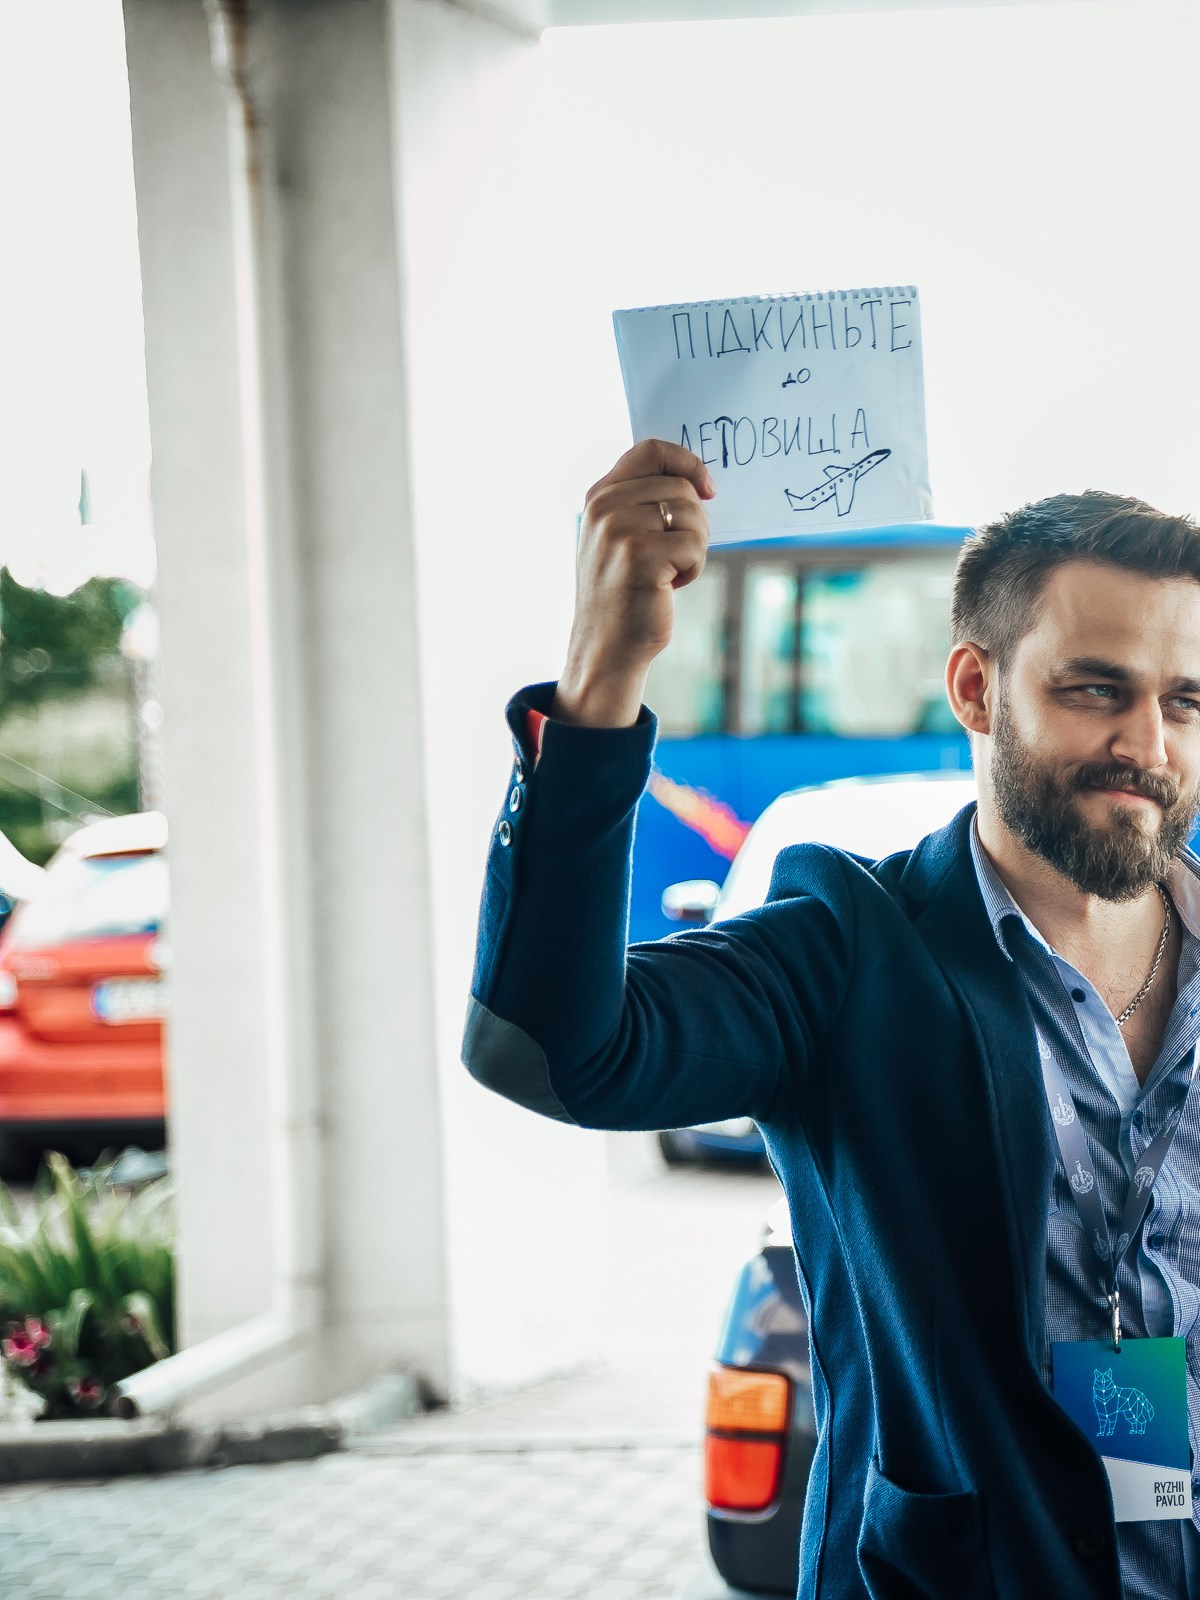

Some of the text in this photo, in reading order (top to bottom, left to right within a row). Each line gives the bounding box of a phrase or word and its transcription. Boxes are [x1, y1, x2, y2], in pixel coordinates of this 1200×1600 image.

[672, 300, 912, 359] ПІДКИНЬТЕ
[1154, 1481, 1184, 1494] RYZHII
[1156, 1494, 1185, 1507] PAVLO
